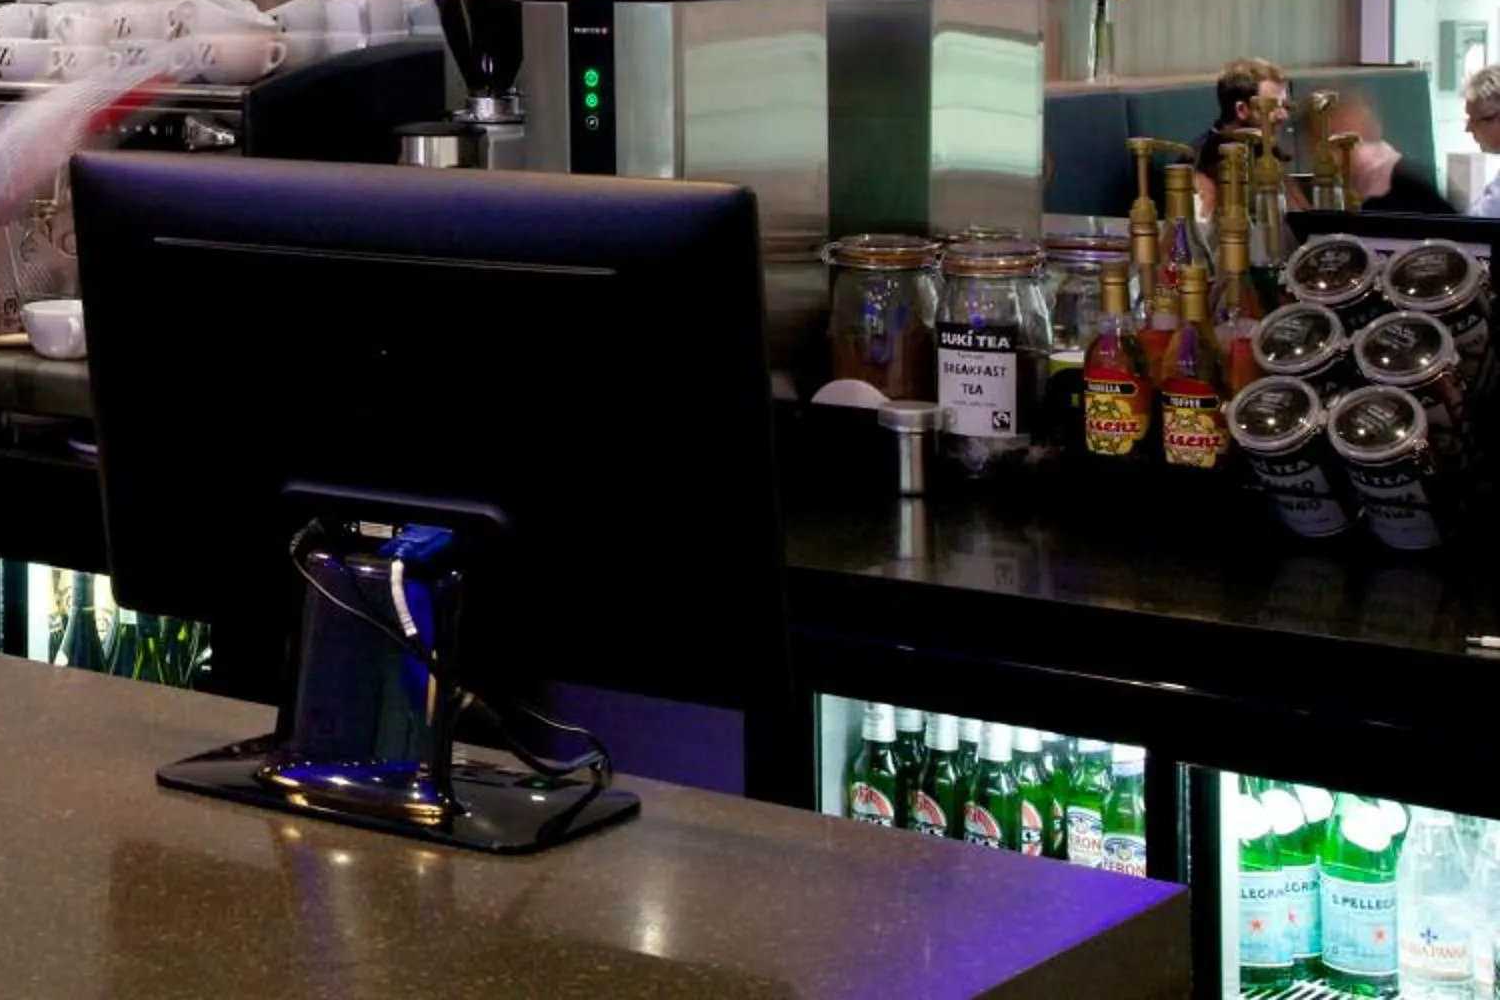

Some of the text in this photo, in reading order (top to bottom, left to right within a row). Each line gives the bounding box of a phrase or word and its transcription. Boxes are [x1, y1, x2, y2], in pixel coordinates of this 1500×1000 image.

[975, 334, 1011, 349] TEA
[943, 361, 1006, 377] BREAKFAST
[961, 383, 984, 396] TEA
